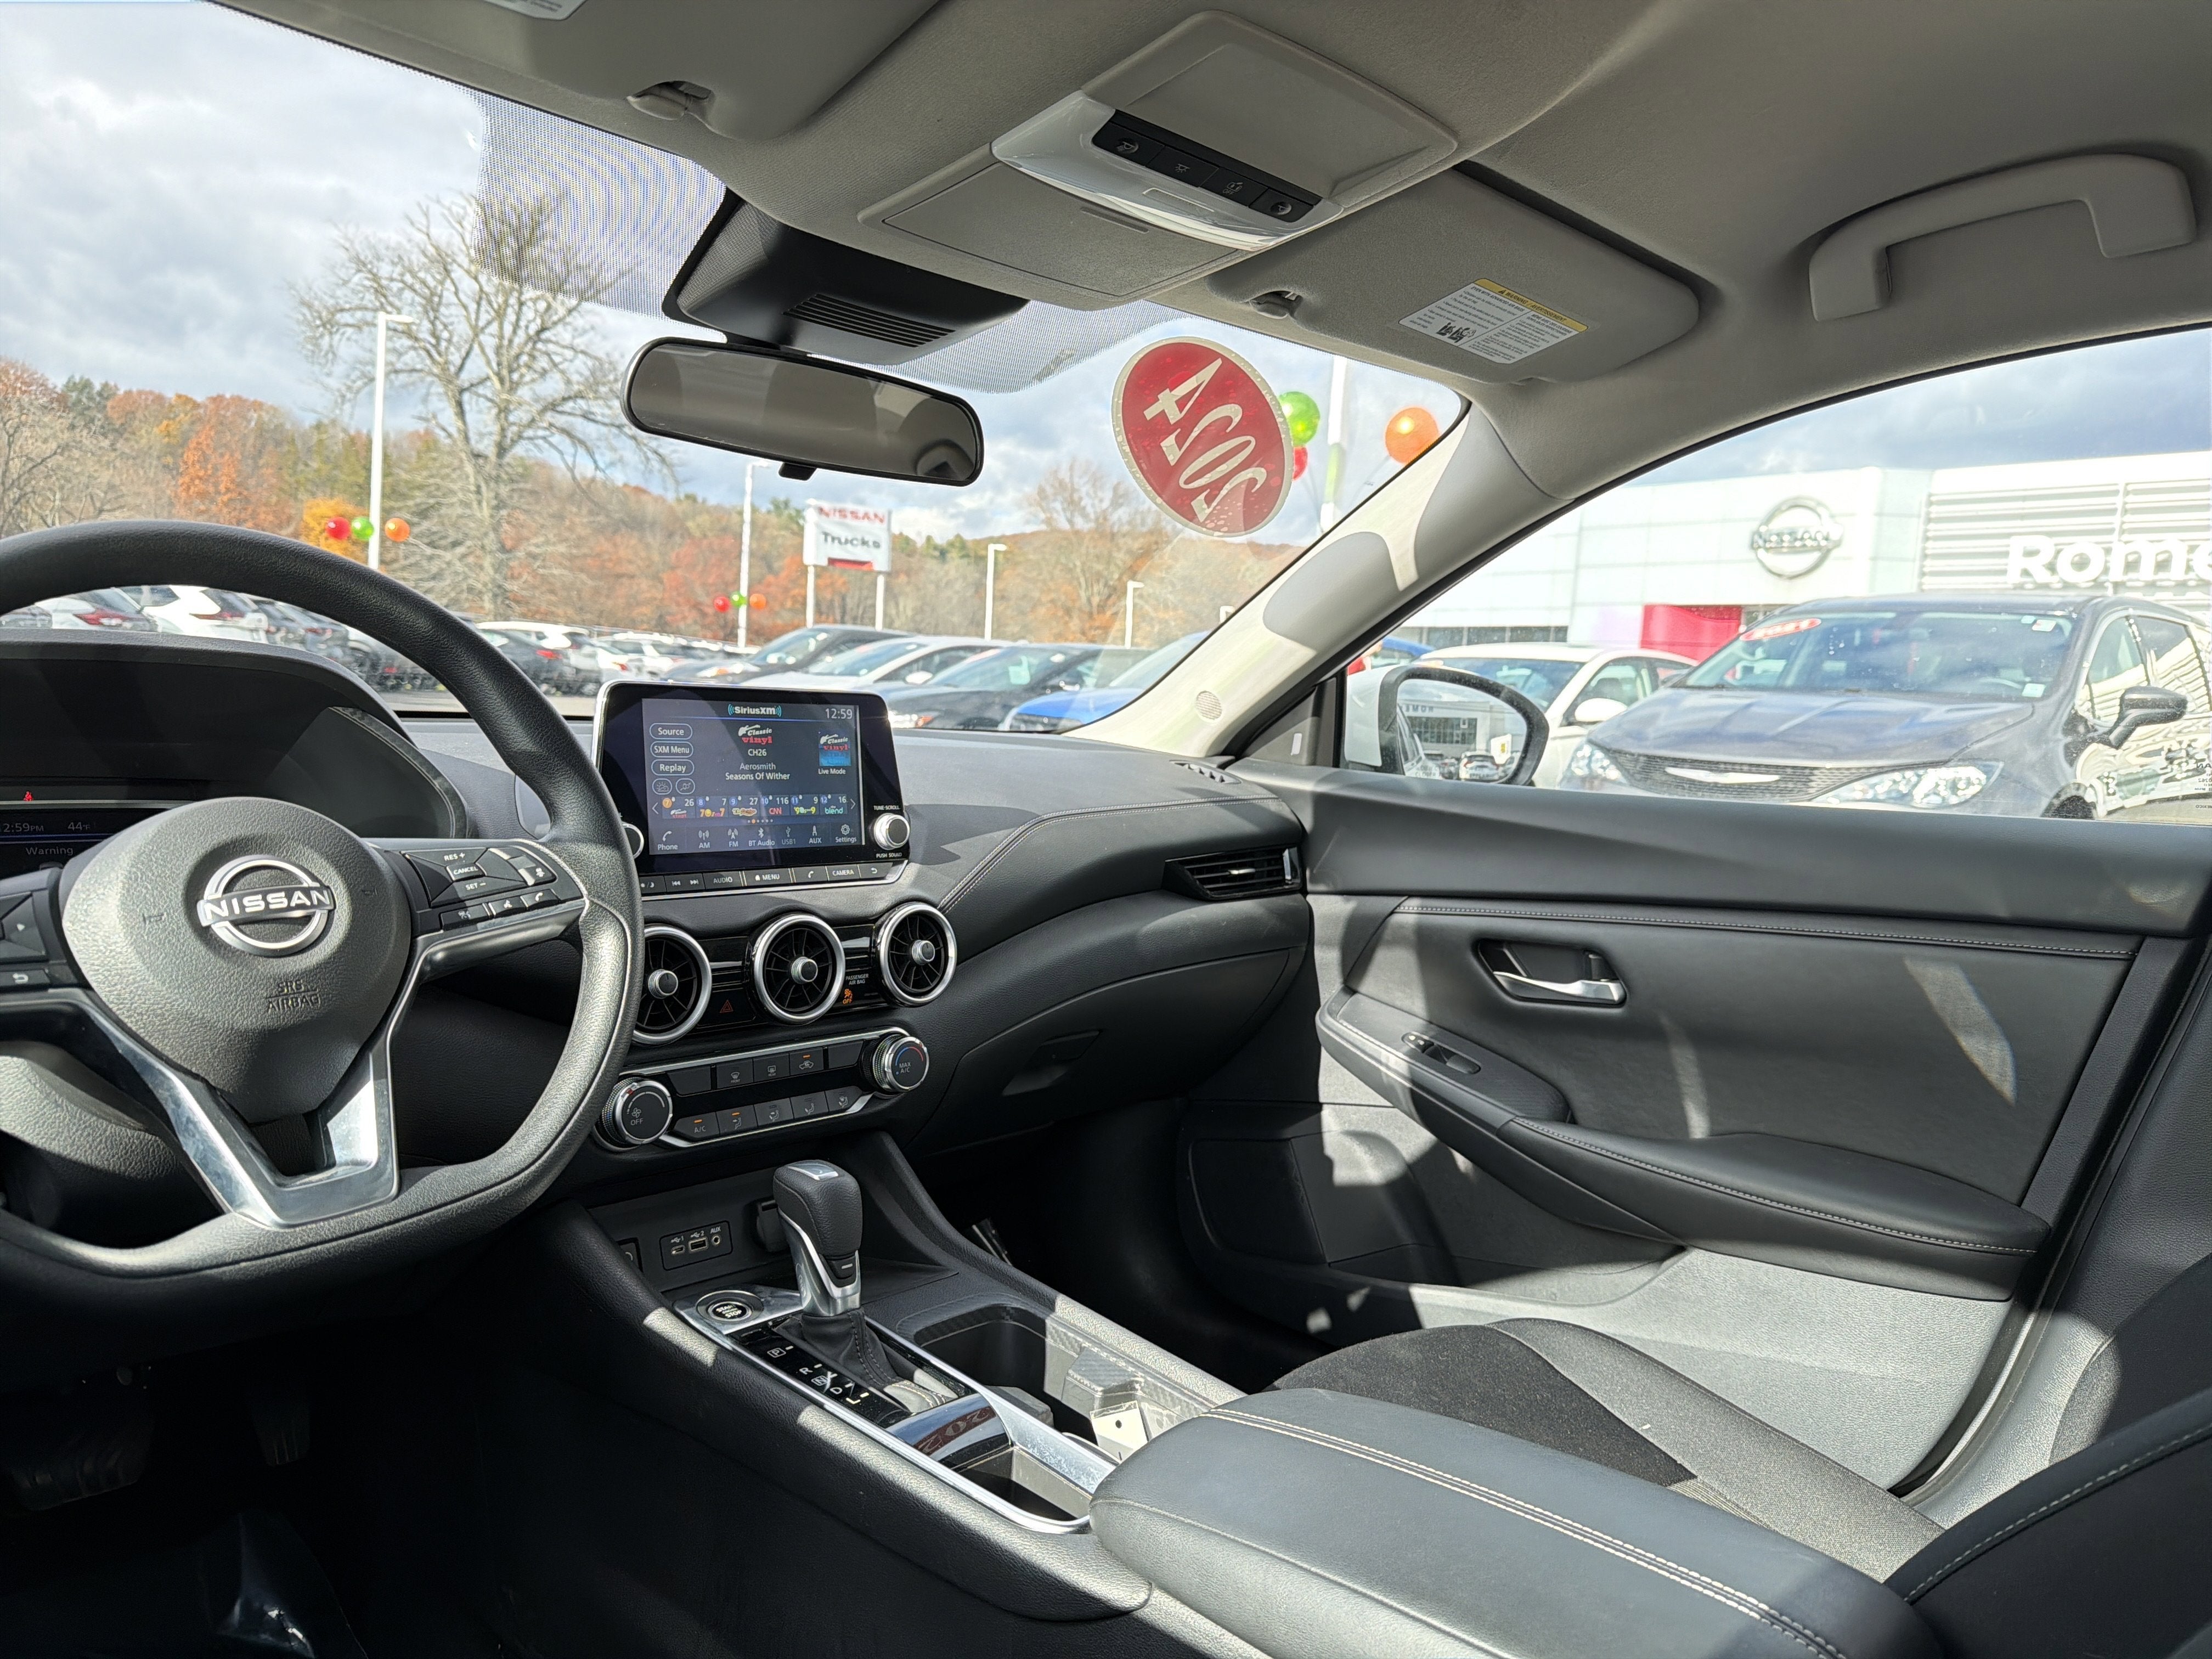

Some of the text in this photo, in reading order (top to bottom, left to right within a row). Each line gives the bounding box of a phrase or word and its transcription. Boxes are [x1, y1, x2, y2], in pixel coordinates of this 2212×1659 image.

[817, 505, 885, 523] NISSAN
[822, 532, 881, 549] Trucks
[825, 708, 853, 719] 12:59
[658, 727, 684, 736] Source
[741, 736, 772, 746] vinyl
[659, 764, 686, 774] Replay
[740, 762, 776, 770] Aerosmith
[26, 846, 74, 856] Warning
[454, 866, 478, 875] CANCEL
[466, 882, 478, 890] SET
[204, 889, 330, 919] NISSAN
[277, 979, 304, 994] SRS
[268, 994, 321, 1013] AIRBAG
[694, 1125, 706, 1133] A/C
[725, 1310, 742, 1318] STOP
